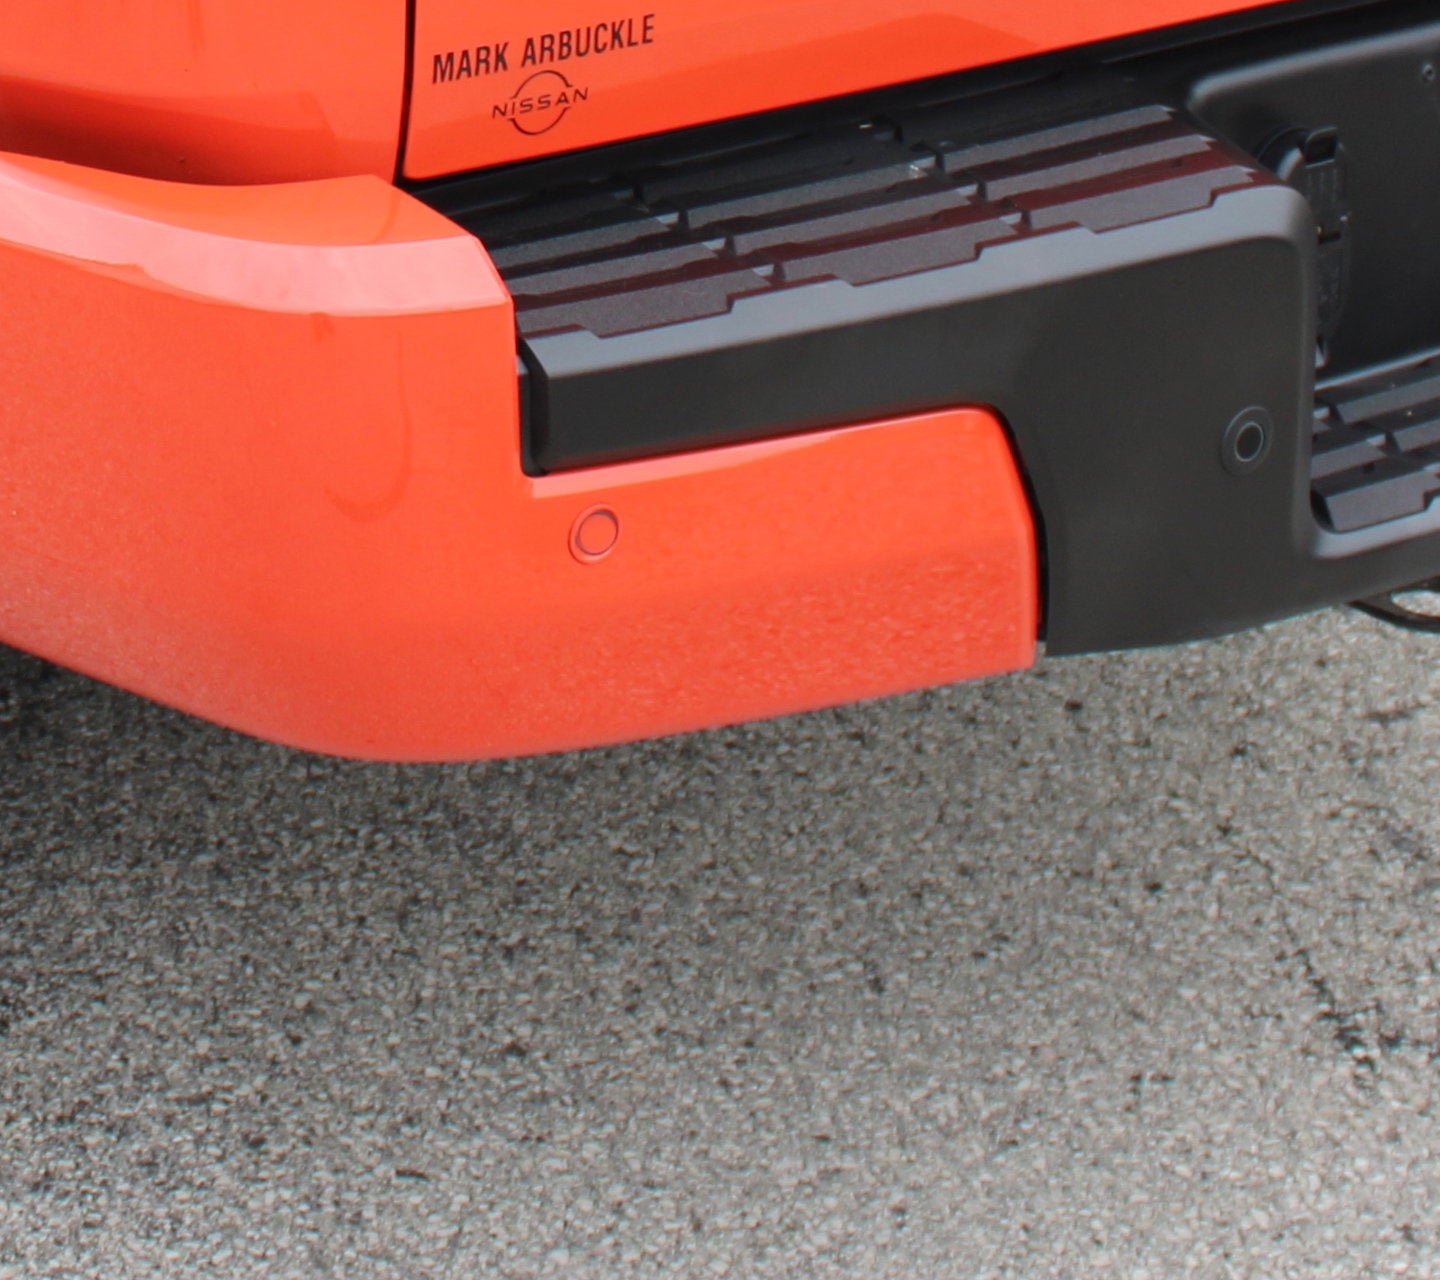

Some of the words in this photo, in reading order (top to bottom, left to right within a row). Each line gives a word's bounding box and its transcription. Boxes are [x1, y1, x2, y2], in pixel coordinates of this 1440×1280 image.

[432, 42, 509, 85] MARK
[521, 13, 655, 68] ARBUCKLE
[492, 87, 589, 119] NISSAN
